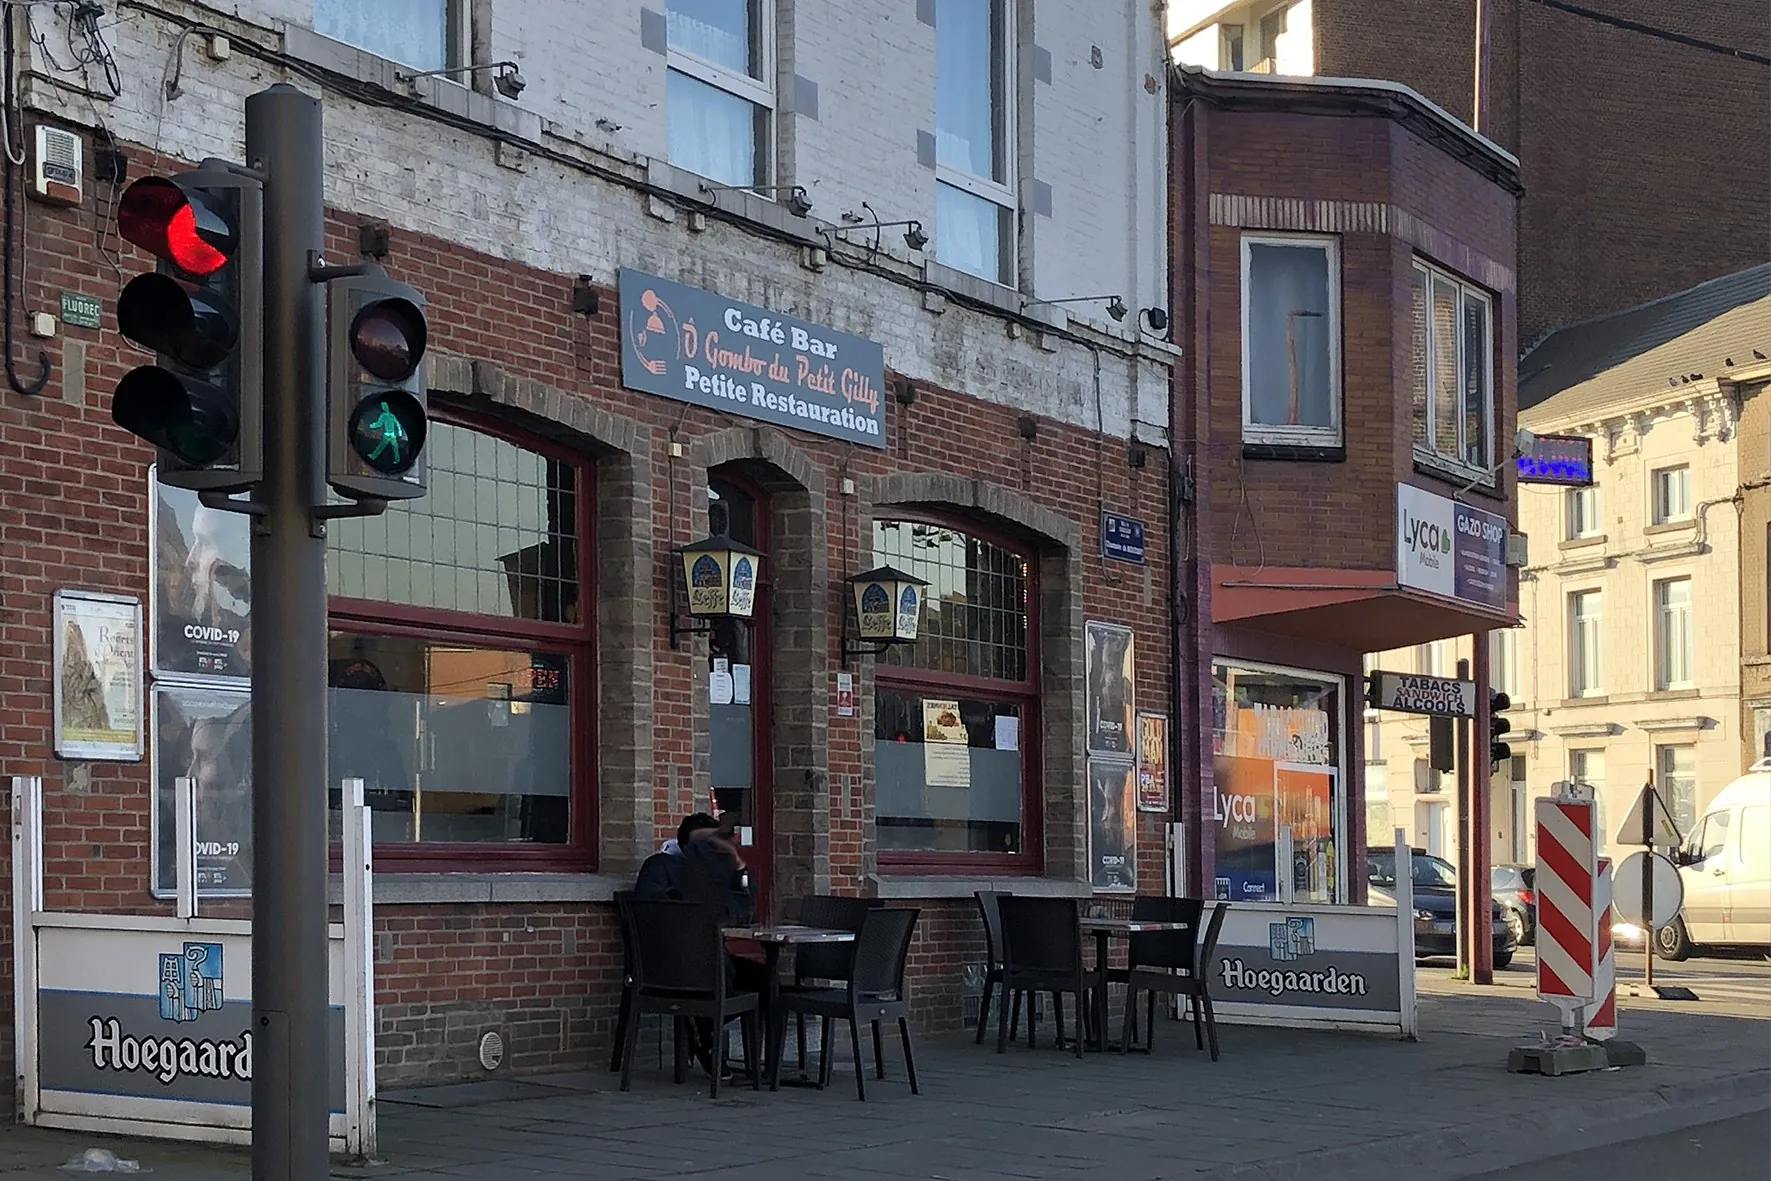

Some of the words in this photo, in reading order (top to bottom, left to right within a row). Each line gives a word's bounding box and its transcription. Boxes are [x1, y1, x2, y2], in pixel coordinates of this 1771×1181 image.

[724, 308, 785, 345] Café
[790, 327, 838, 360] Bar
[704, 331, 768, 376] Gombo
[769, 352, 790, 384] du
[796, 355, 836, 396] Petit
[841, 367, 880, 415] Gilly
[684, 365, 748, 402] Petite
[750, 382, 880, 436] Restauration
[1403, 508, 1439, 552] Lyca
[1457, 514, 1481, 538] GAZO
[1482, 522, 1503, 544] SHOP
[184, 624, 241, 643] COVID-19
[1393, 695, 1465, 714] ALCOOLS
[1396, 687, 1463, 703] SANDWICH
[1399, 676, 1461, 694] TABACS
[1213, 786, 1256, 828] Lyca
[1220, 958, 1367, 996] Hoegaarden
[87, 1017, 252, 1084] Hoegaard
